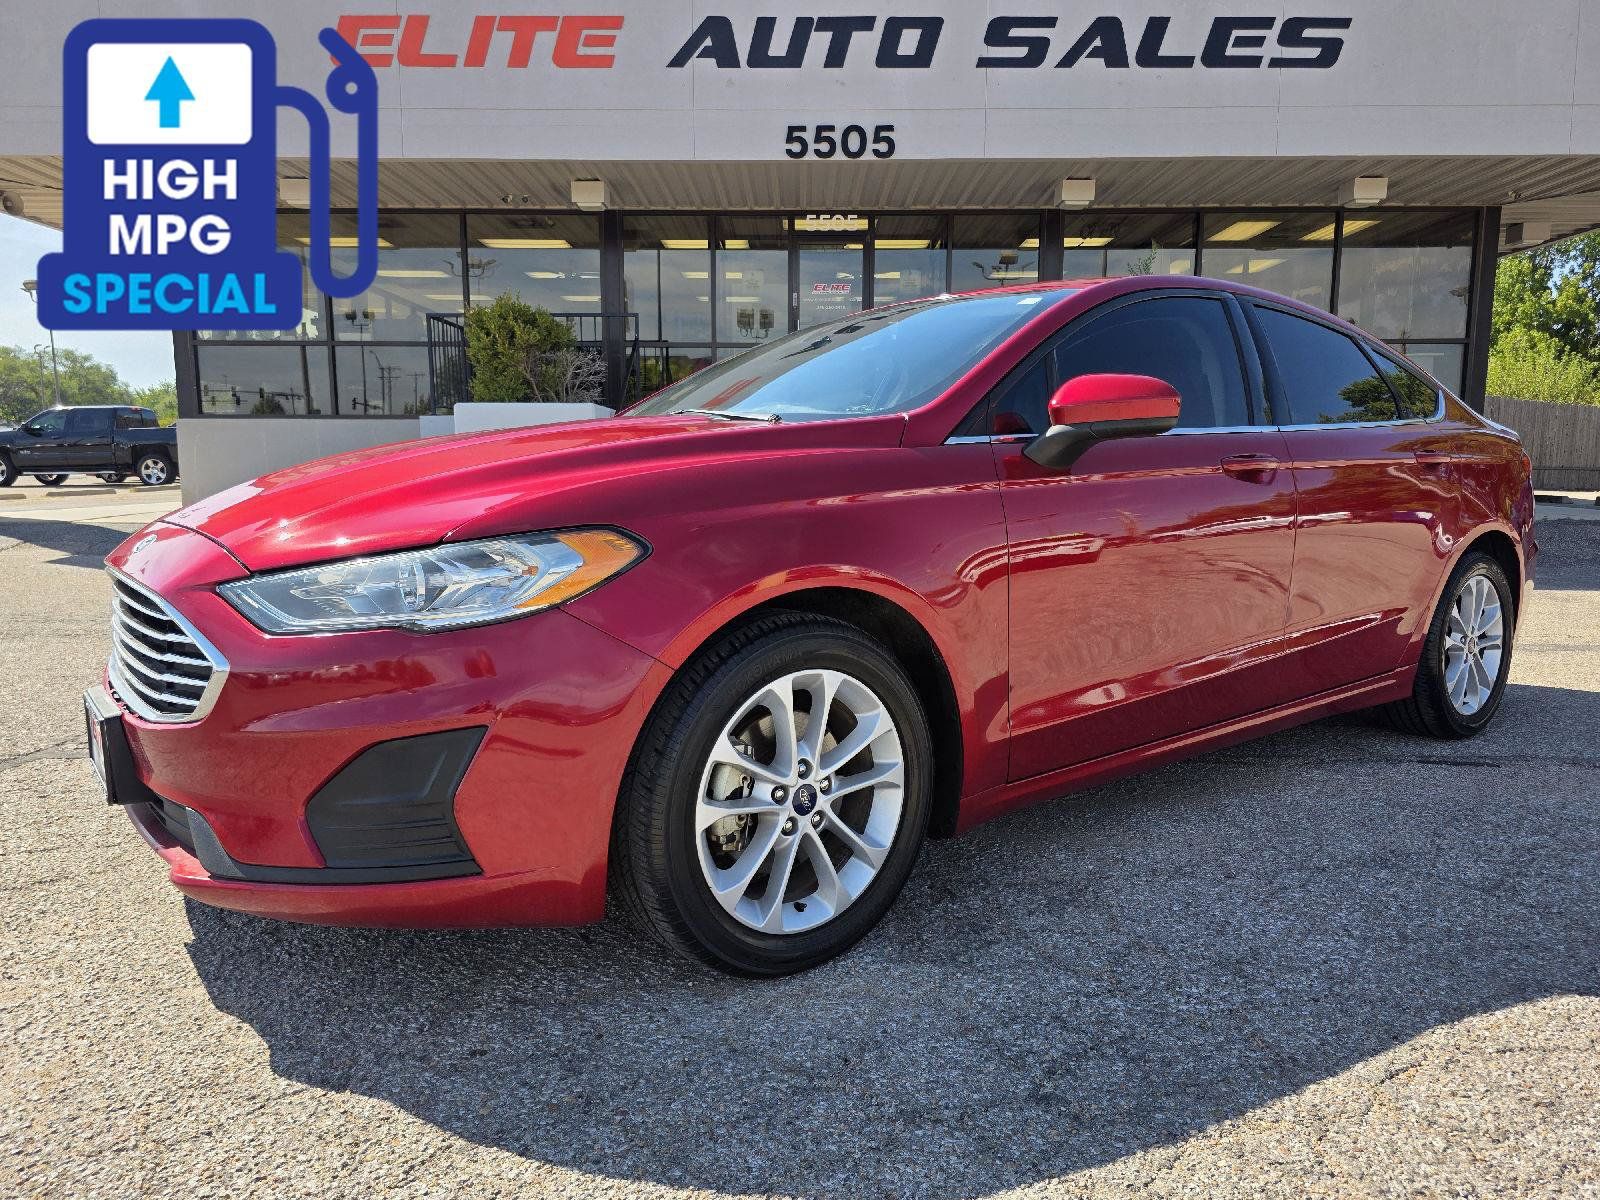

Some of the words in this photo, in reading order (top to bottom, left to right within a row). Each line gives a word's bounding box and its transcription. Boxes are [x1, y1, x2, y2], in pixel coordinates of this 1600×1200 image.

[329, 14, 625, 69] ELITE
[666, 15, 945, 69] AUTO
[975, 15, 1353, 69] SALES
[784, 124, 896, 160] 5505
[805, 214, 858, 232] 5505
[812, 283, 852, 292] ELITE
